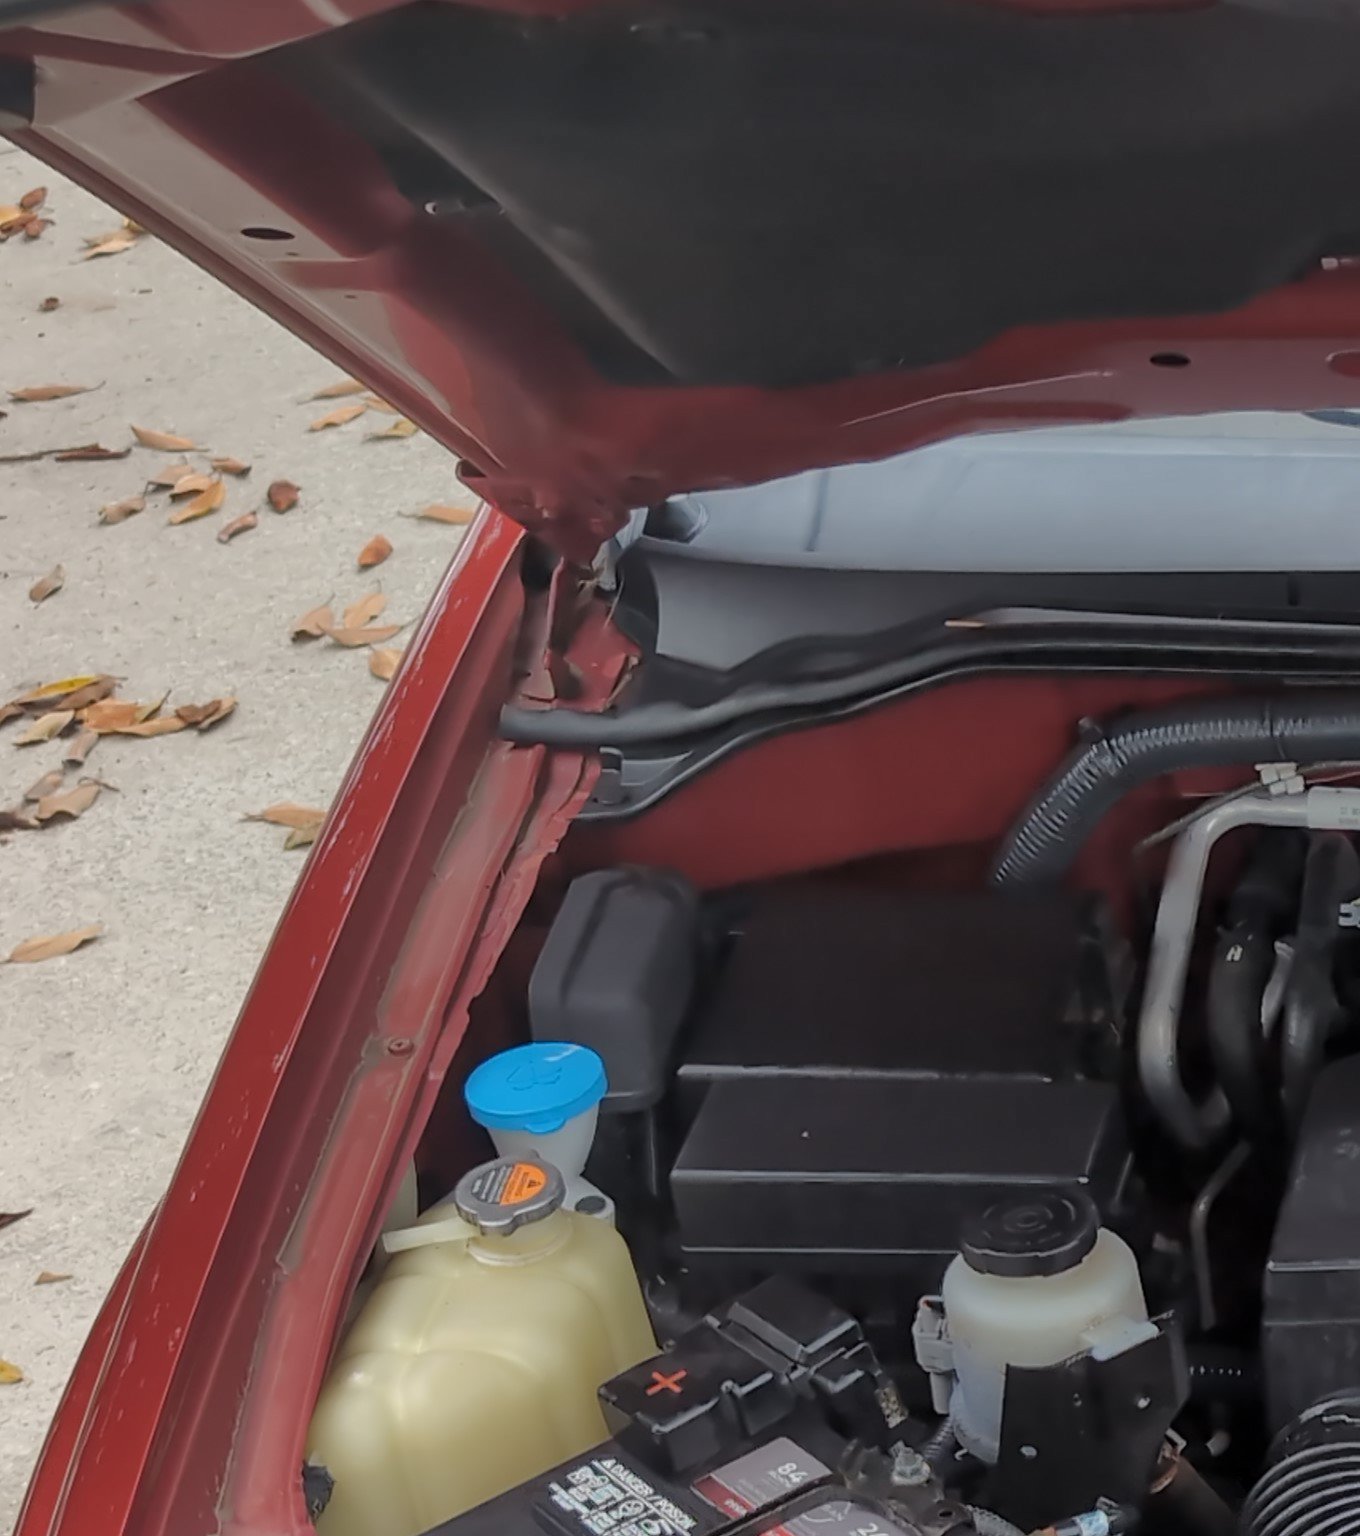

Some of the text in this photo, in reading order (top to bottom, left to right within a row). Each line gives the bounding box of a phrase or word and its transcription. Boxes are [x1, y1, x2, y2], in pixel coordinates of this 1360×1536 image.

[777, 1463, 808, 1484] 84
[611, 1463, 655, 1496] DANGER
[655, 1497, 697, 1529] POISON
